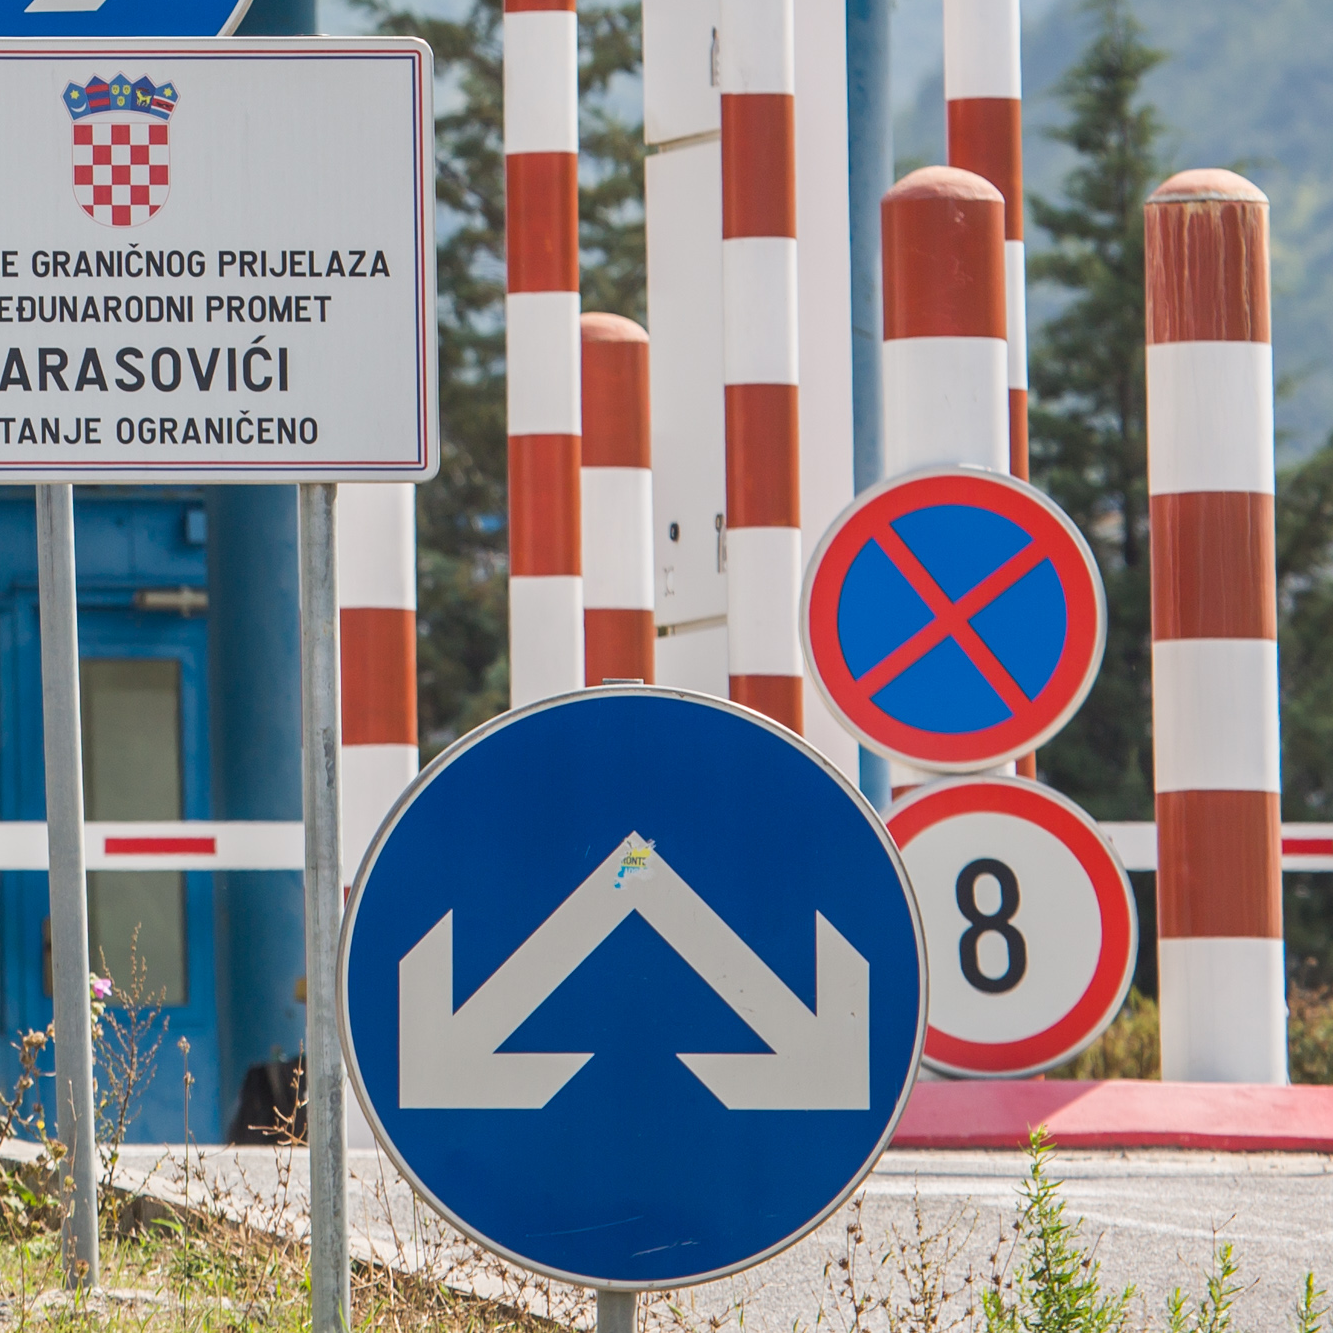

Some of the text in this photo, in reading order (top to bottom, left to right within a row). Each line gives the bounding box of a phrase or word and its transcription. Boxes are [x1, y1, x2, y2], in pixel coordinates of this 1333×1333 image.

[31, 243, 207, 279] GRANIČNOG
[218, 250, 392, 279] PRIJELAZA
[206, 295, 333, 324] PROMET
[115, 410, 319, 446] OGRANIČENO
[955, 857, 1027, 995] 8
